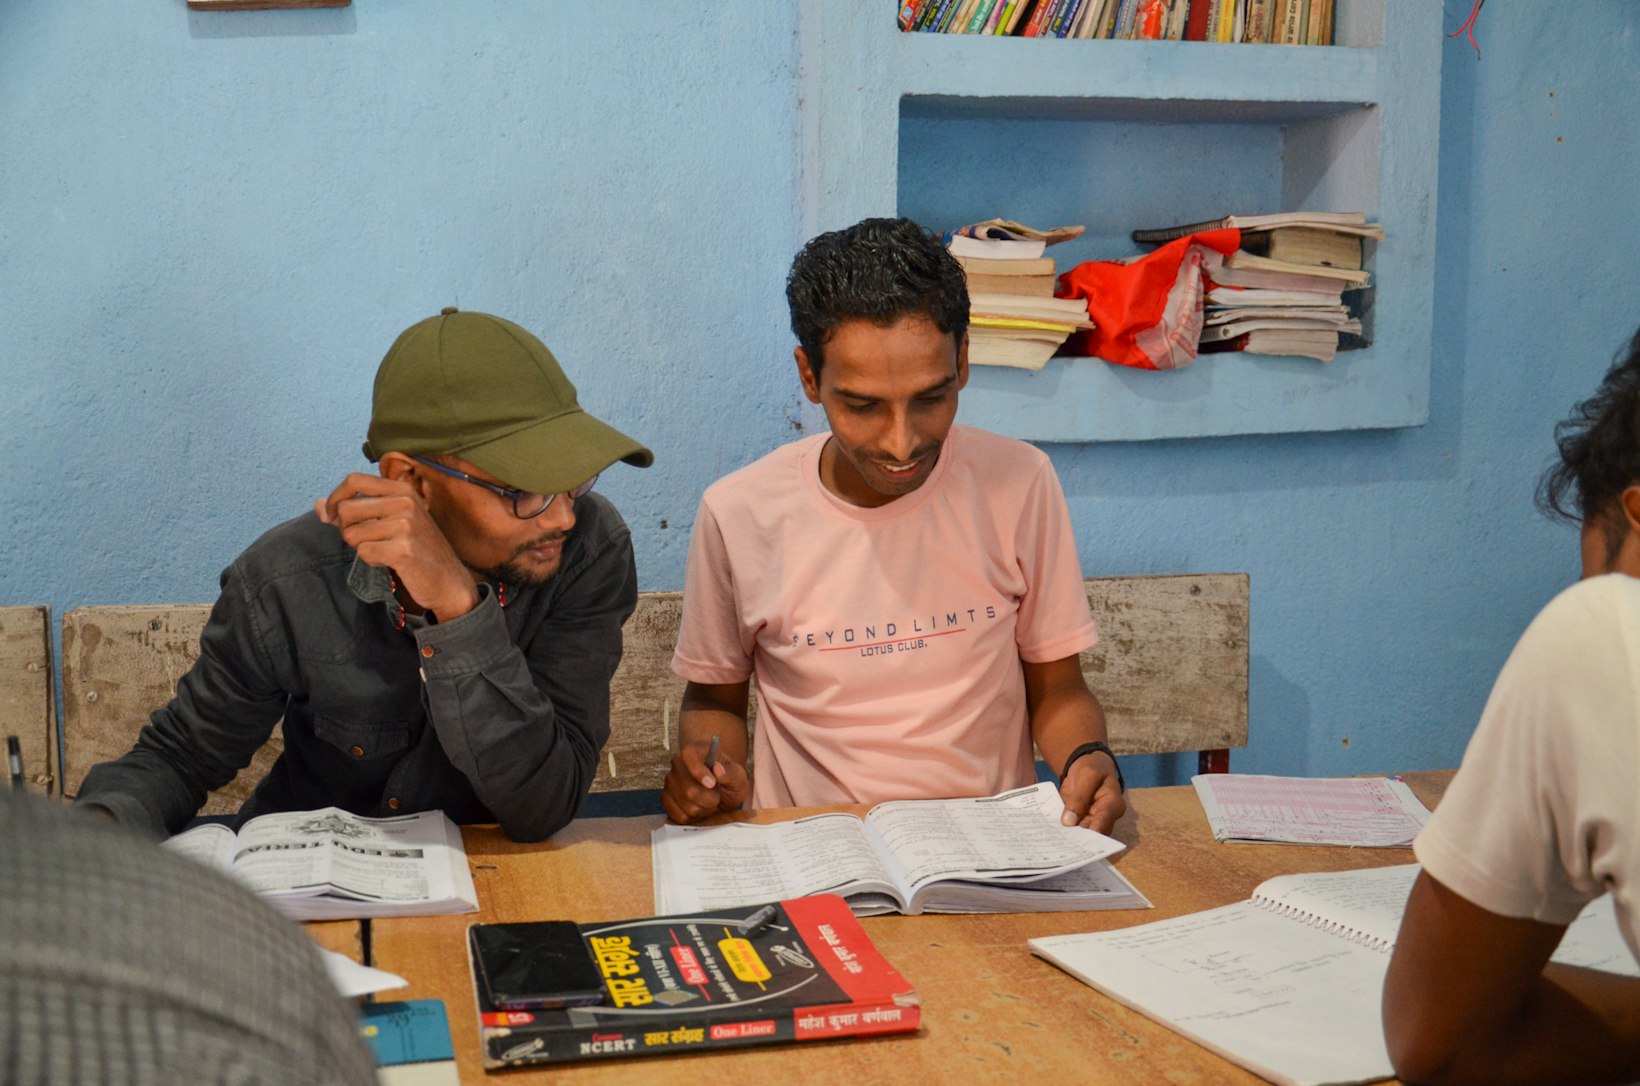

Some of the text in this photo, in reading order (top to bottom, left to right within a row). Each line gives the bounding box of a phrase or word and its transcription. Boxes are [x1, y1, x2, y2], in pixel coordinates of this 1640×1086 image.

[913, 606, 996, 632] LIMTS
[860, 639, 928, 657] LOTUS CLUB.
[589, 935, 640, 977] संग्रह
[677, 947, 698, 968] Liner
[687, 968, 706, 983] One
[606, 978, 654, 1008] सार
[713, 1023, 773, 1038] One Liner
[798, 1013, 825, 1029] महेश
[828, 1013, 858, 1032] कुमार
[580, 1038, 636, 1055] NCERT
[643, 1031, 669, 1046] सार
